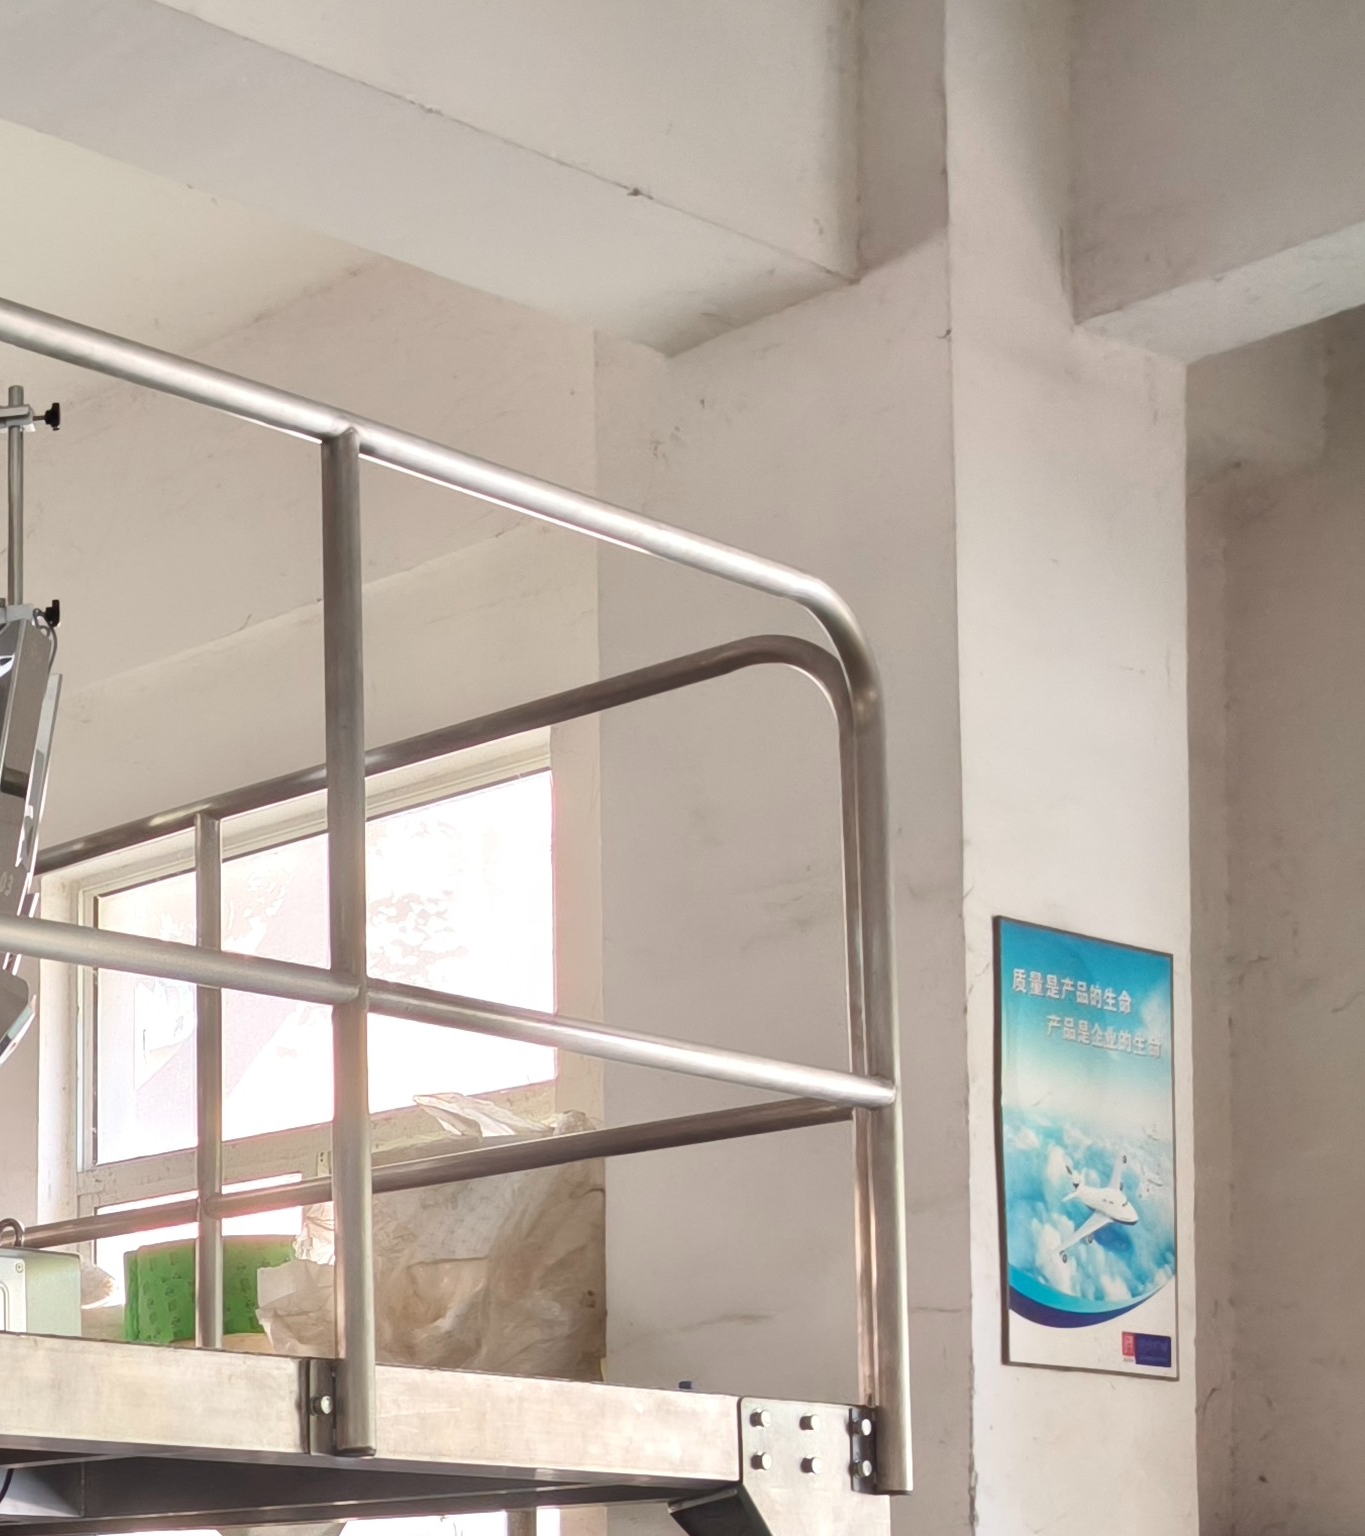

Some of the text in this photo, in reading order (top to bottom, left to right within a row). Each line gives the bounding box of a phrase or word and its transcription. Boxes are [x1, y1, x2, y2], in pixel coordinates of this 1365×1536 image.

[1012, 967, 1132, 1015] 质量是产品的生命
[1046, 1014, 1162, 1059] 产品是企业的生命
